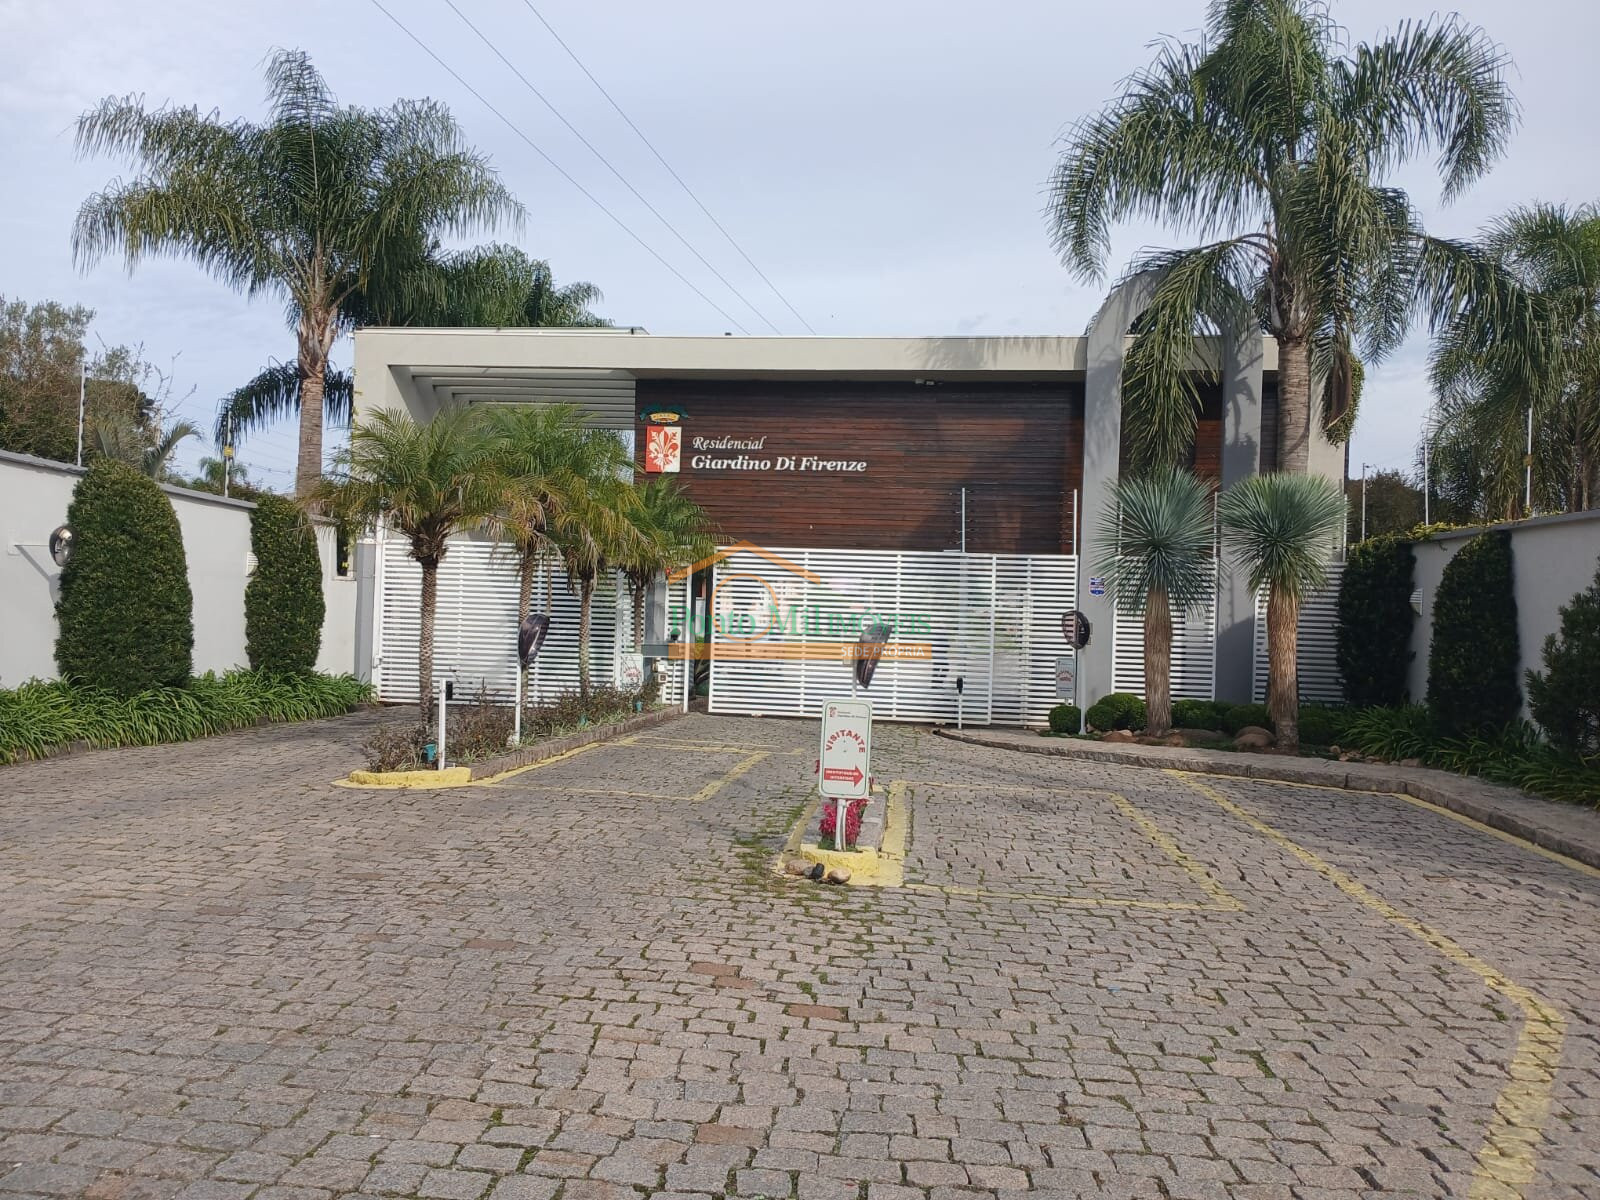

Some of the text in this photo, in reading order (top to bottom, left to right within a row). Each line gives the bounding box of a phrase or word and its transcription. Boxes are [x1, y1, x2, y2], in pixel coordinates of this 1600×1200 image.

[692, 436, 766, 450] Residencial
[691, 455, 867, 472] Giardino Di Firenze
[825, 729, 866, 753] VISITANTE
